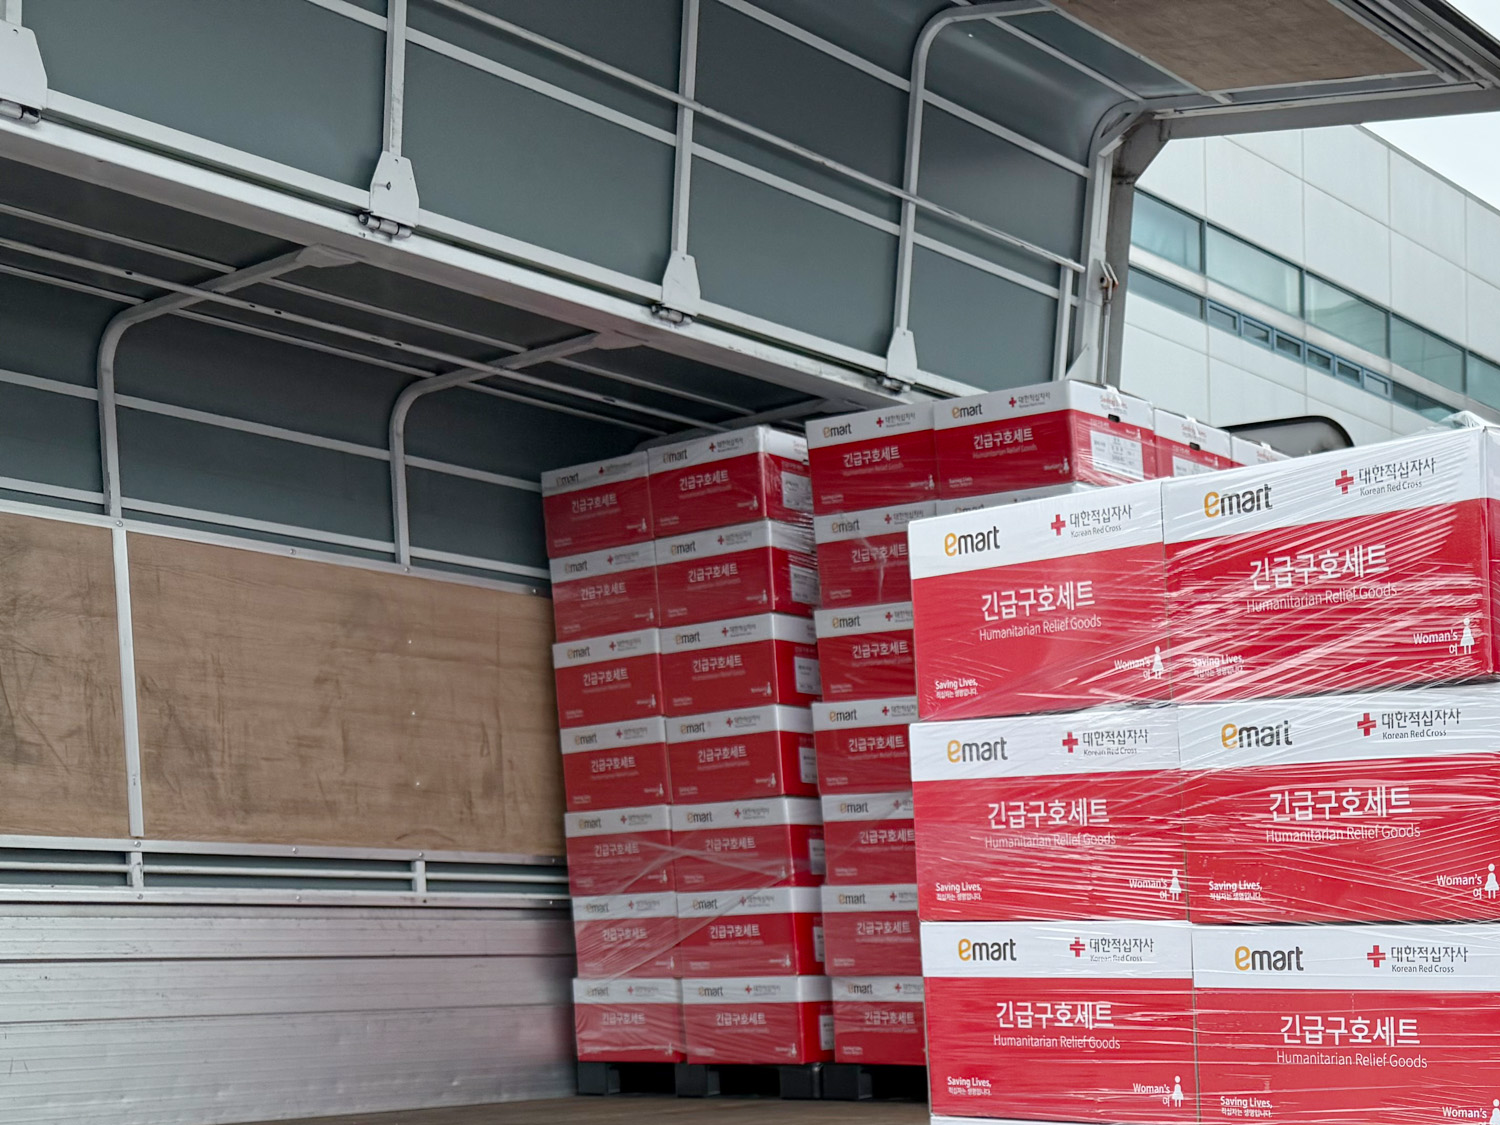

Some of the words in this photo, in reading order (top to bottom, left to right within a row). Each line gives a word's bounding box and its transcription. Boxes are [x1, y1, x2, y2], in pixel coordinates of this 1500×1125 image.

[951, 402, 983, 419] emart
[823, 422, 853, 438] emart
[1358, 457, 1437, 485] 대한적십자사
[1203, 483, 1273, 519] emart
[1069, 504, 1133, 529] 대한적십자사
[944, 525, 1001, 557] emart
[1249, 543, 1390, 591] 긴급구호세트
[981, 580, 1096, 621] 긴급구호세트
[674, 630, 701, 645] emart
[978, 622, 1041, 641] Humanitarian
[1042, 617, 1070, 634] Relief
[1070, 614, 1103, 631] Goods
[828, 708, 858, 722] emart
[1381, 708, 1462, 730] 대한적십자사
[679, 721, 706, 735] emart
[1082, 728, 1149, 747] 대한적십자사
[1221, 719, 1293, 750] emart
[947, 737, 1008, 764] emart
[988, 797, 1110, 830] 긴급구호세트
[1269, 786, 1413, 822] 긴급구호세트
[957, 938, 1017, 962] emart
[1089, 937, 1155, 953] 대한적십자사
[1390, 945, 1469, 963] 대한적십자사
[1234, 946, 1304, 972] emart
[1391, 964, 1418, 973] Korean
[1418, 964, 1433, 973] Red
[1433, 964, 1455, 973] Cross
[996, 1000, 1114, 1031] 긴급구호세트
[993, 1034, 1058, 1048] Humanitarian
[1059, 1035, 1087, 1049] Relief
[1088, 1036, 1121, 1050] Goods
[1280, 1014, 1421, 1048] 긴급구호세트
[1276, 1050, 1353, 1066] Humanitarian
[1355, 1052, 1388, 1067] Relief
[1389, 1054, 1428, 1069] Goods
